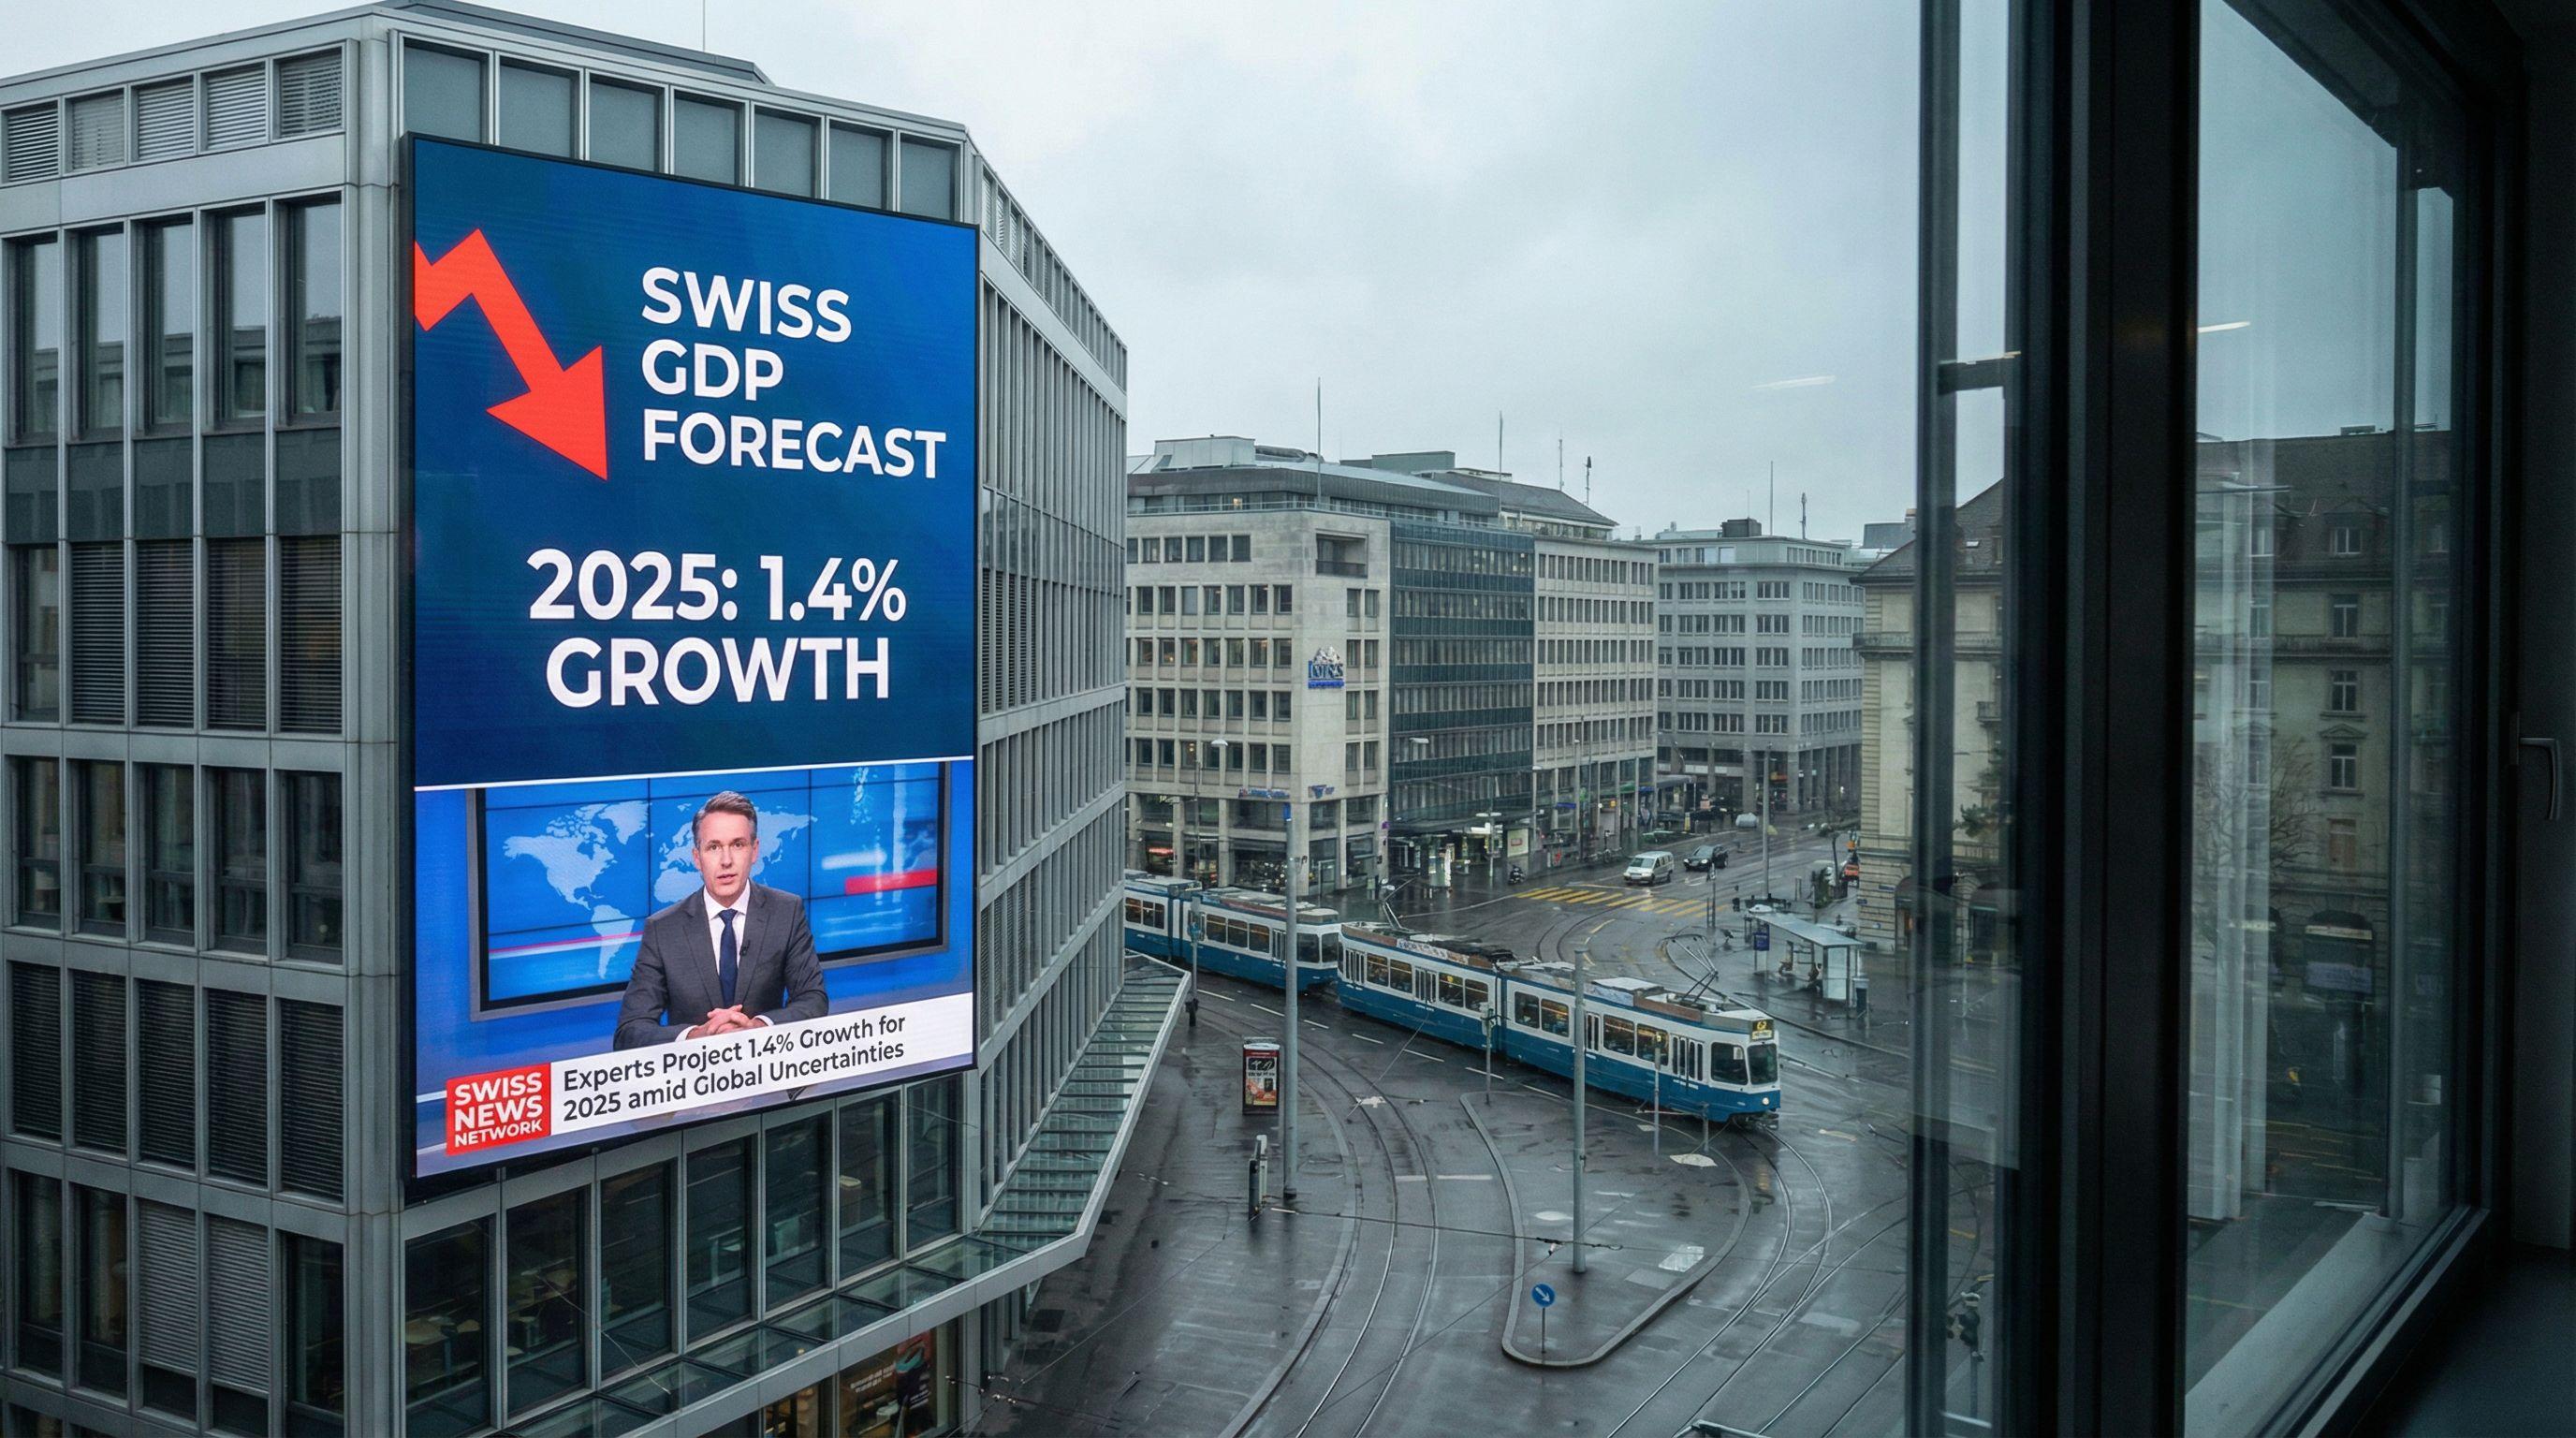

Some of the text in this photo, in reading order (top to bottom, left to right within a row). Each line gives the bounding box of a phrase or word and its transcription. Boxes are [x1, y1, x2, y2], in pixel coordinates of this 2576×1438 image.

[641, 267, 852, 343] SWISS
[641, 339, 783, 402] GDP
[642, 408, 946, 478] FORECAST
[526, 548, 907, 622] 2025: 1.4%
[546, 637, 889, 708] GROWTH
[454, 1071, 543, 1106] SWISS
[564, 1015, 906, 1092] Experts Project 1.4% Growth for
[564, 1040, 904, 1122] 2025 amid Global Uncertainties
[454, 1093, 544, 1132] NEWS
[454, 1119, 543, 1148] NETWORK
